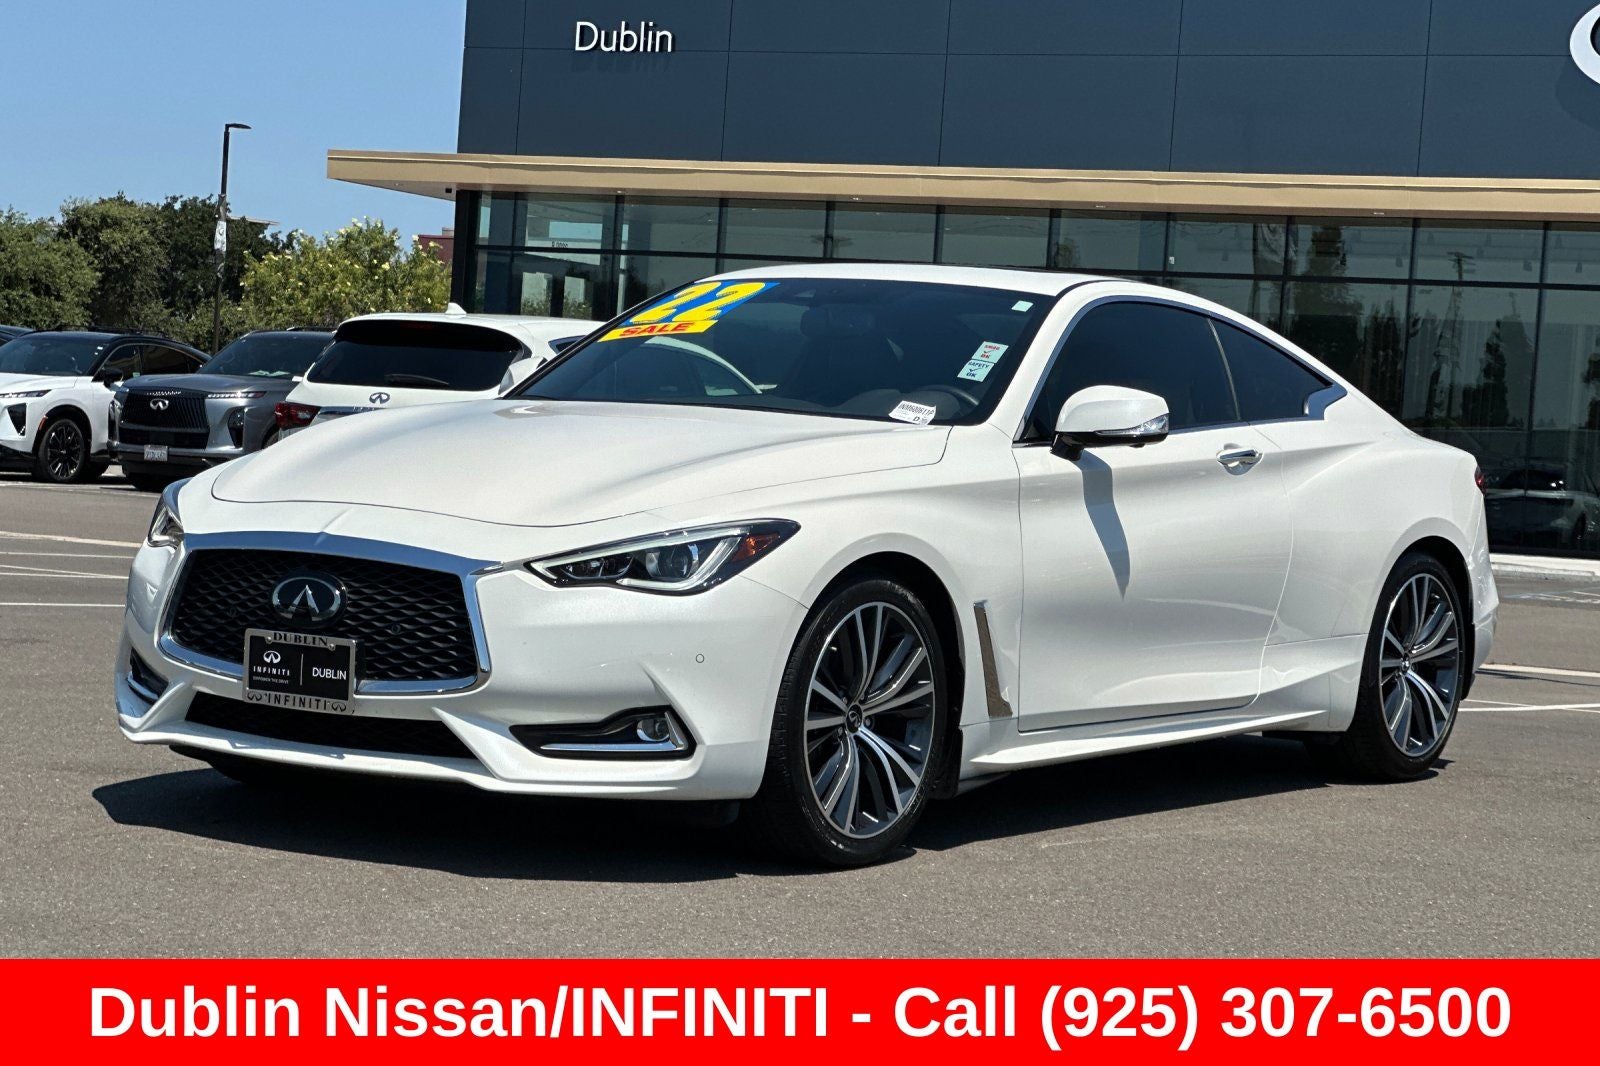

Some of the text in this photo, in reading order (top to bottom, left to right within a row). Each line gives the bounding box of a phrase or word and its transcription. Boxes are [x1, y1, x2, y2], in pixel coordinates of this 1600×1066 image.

[575, 20, 673, 52] Dublin
[630, 281, 765, 325] 22
[619, 321, 695, 337] SALE
[273, 632, 328, 647] DUBLIN
[253, 665, 290, 677] INFINITI
[312, 667, 347, 680] DUBLIN
[268, 693, 327, 711] INFINITI
